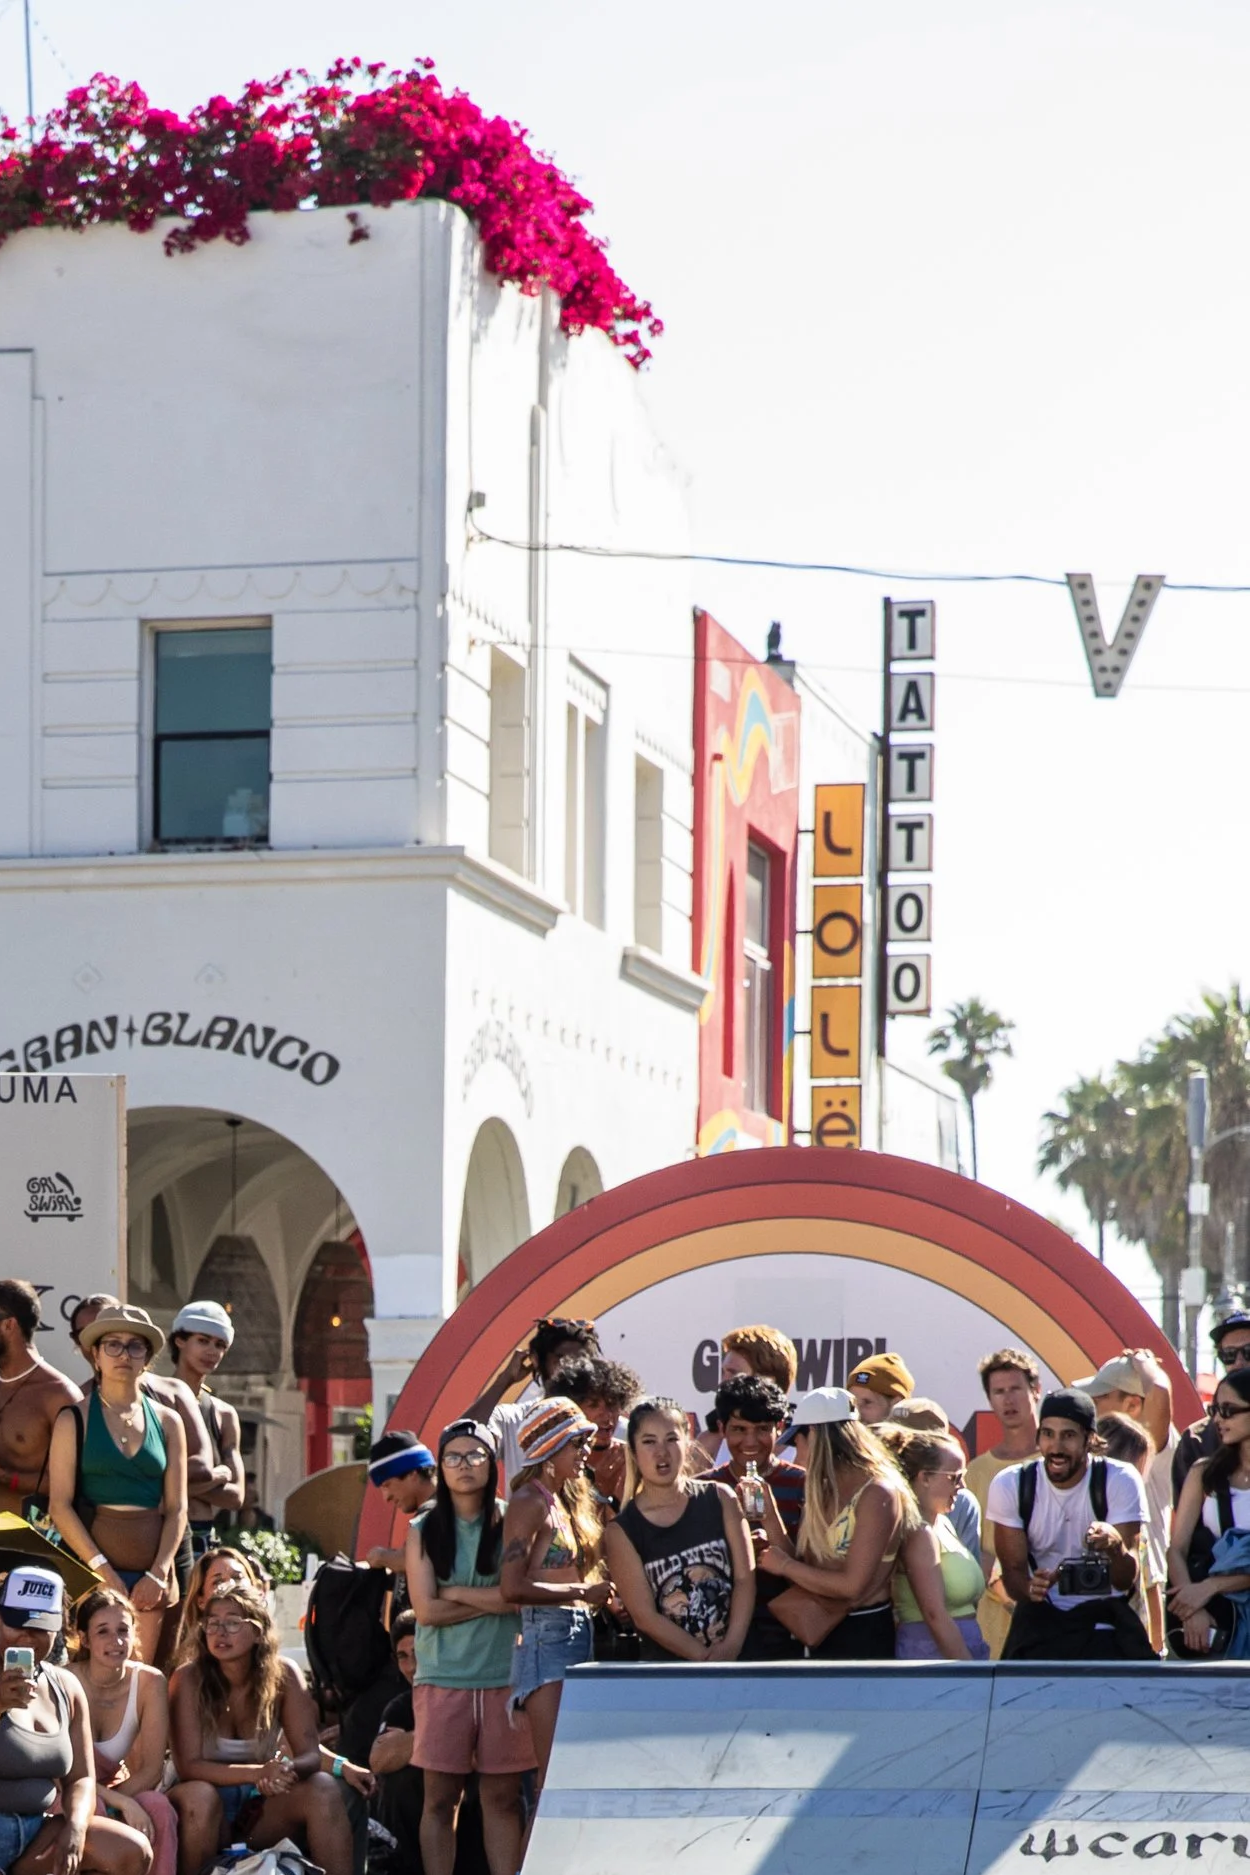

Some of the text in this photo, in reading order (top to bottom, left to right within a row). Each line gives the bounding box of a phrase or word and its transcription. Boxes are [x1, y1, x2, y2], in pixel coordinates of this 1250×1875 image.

[1065, 572, 1166, 697] V
[893, 606, 926, 1003] TATTOO
[141, 1011, 341, 1086] BLANCO
[18, 1579, 56, 1597] JUICE
